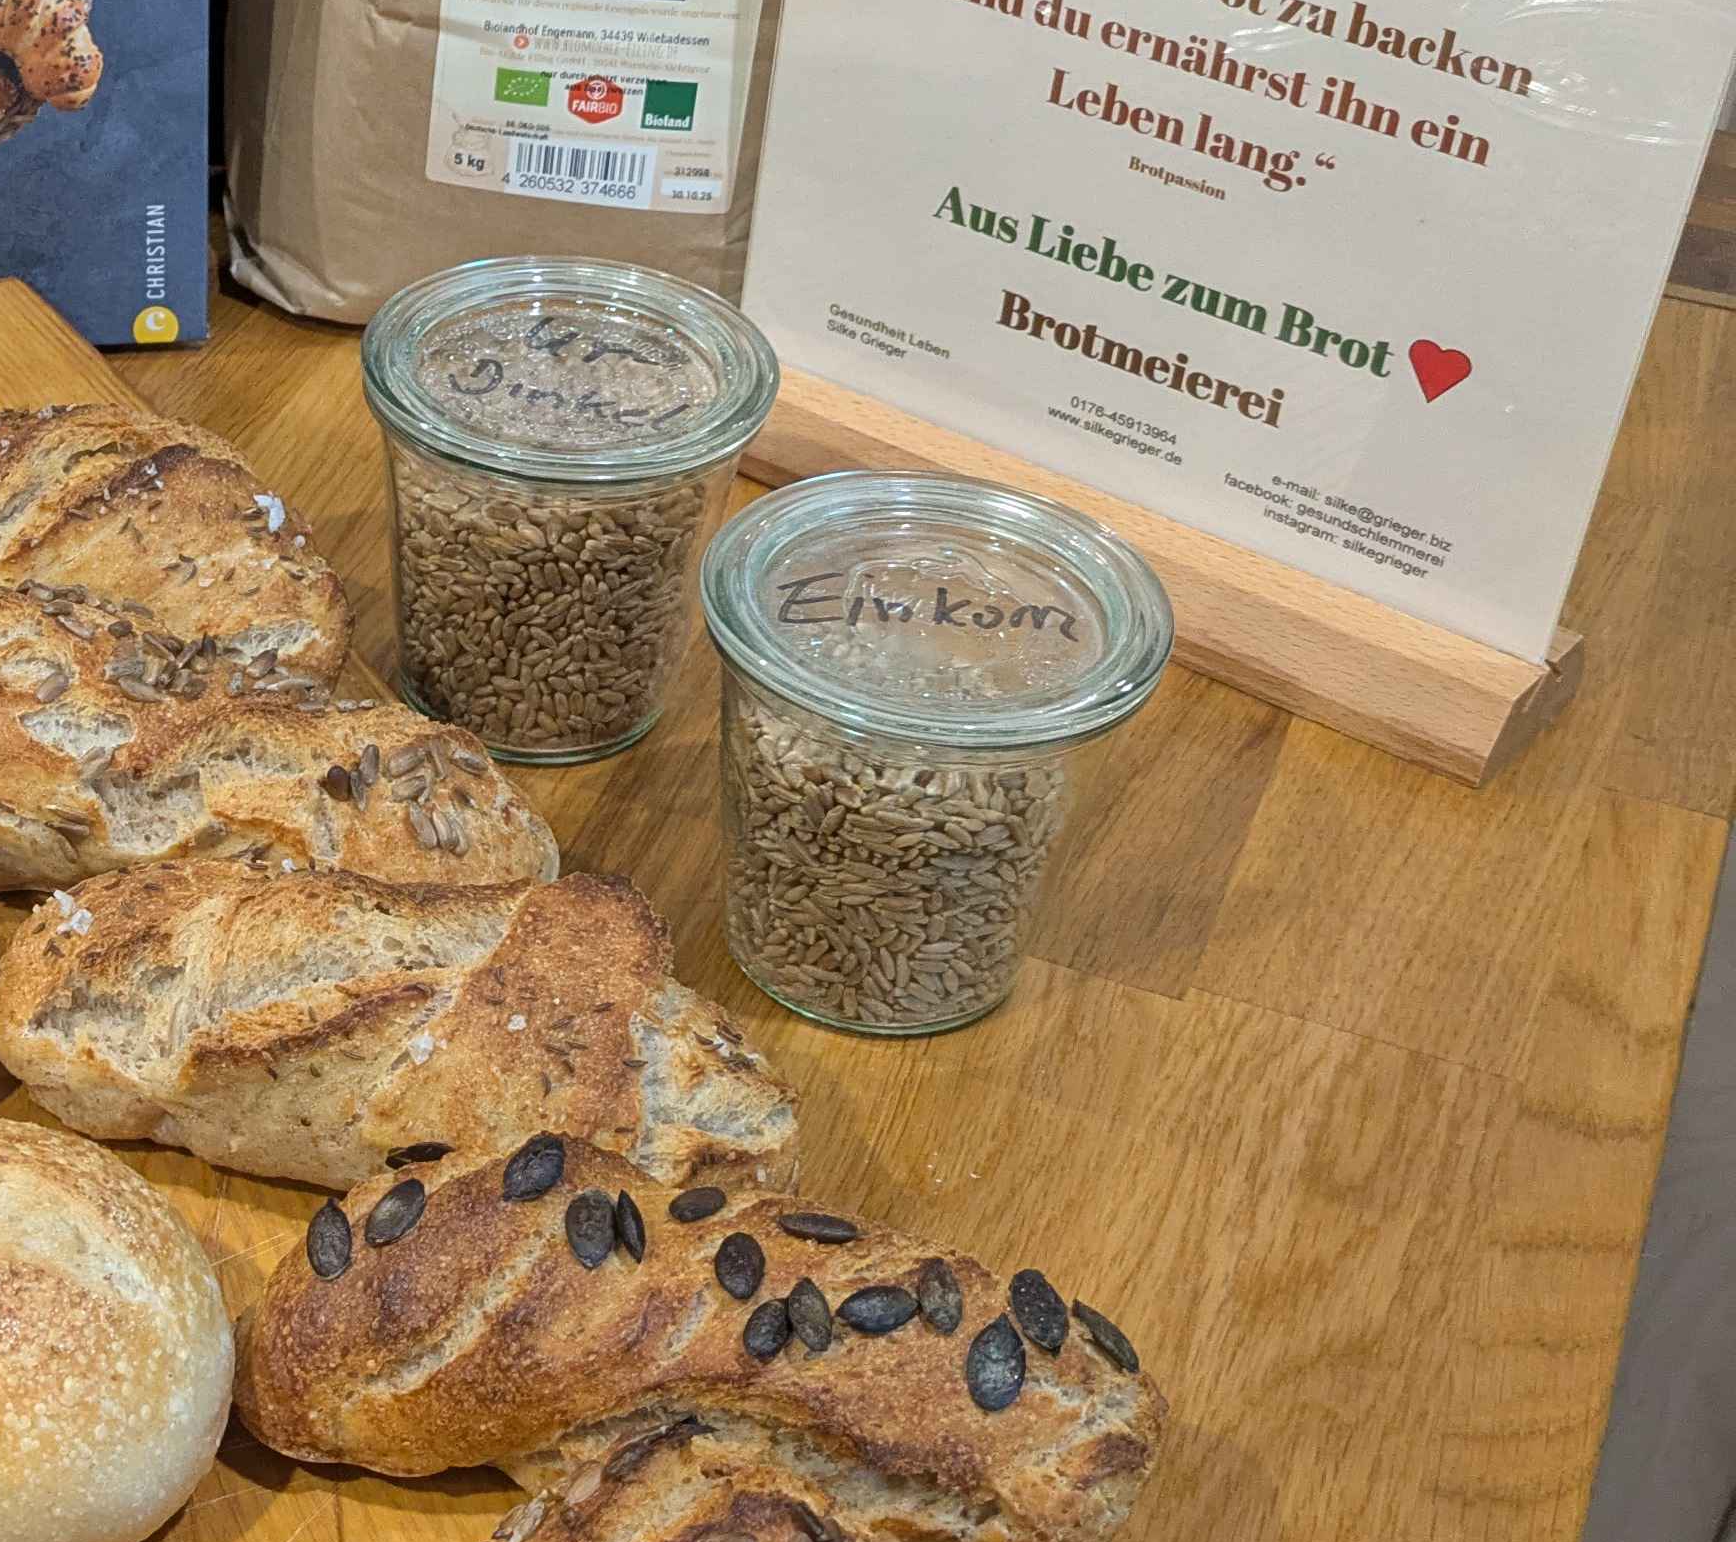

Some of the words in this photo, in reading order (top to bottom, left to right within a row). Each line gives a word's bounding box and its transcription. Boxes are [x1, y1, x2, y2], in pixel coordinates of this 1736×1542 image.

[1345, 3, 1534, 98] backen
[572, 100, 617, 115] FAIRBIO
[644, 114, 691, 129] Bioland
[1045, 67, 1186, 144] Leben
[1100, 18, 1312, 112] ernährst
[1317, 78, 1401, 138] ihn
[1410, 114, 1492, 167] ein
[454, 153, 463, 165] 5
[467, 154, 486, 172] kg
[501, 173, 511, 184] 4
[519, 174, 576, 195] 260532
[1128, 156, 1227, 201] Brotpassion
[145, 203, 166, 299] CHRISTIAN
[933, 185, 1019, 245] Aus
[1023, 214, 1155, 292] Liebe
[1161, 271, 1267, 335] zum
[1273, 301, 1395, 379] Brot
[826, 319, 858, 341] Silke
[861, 330, 908, 361] Grieger
[829, 303, 907, 340] Gesundheit
[909, 329, 951, 360] Leben
[995, 289, 1289, 429] Brotmeierei
[1047, 404, 1183, 467] www.silkegrieger.de
[1223, 471, 1293, 513] facebook:
[1295, 496, 1446, 569] gesundschlemmerei
[1262, 505, 1338, 550] instagram:
[1342, 534, 1430, 580] silkegrieger
[1271, 473, 1320, 502] e-mail:
[1324, 491, 1452, 553] silke@grieger.biz
